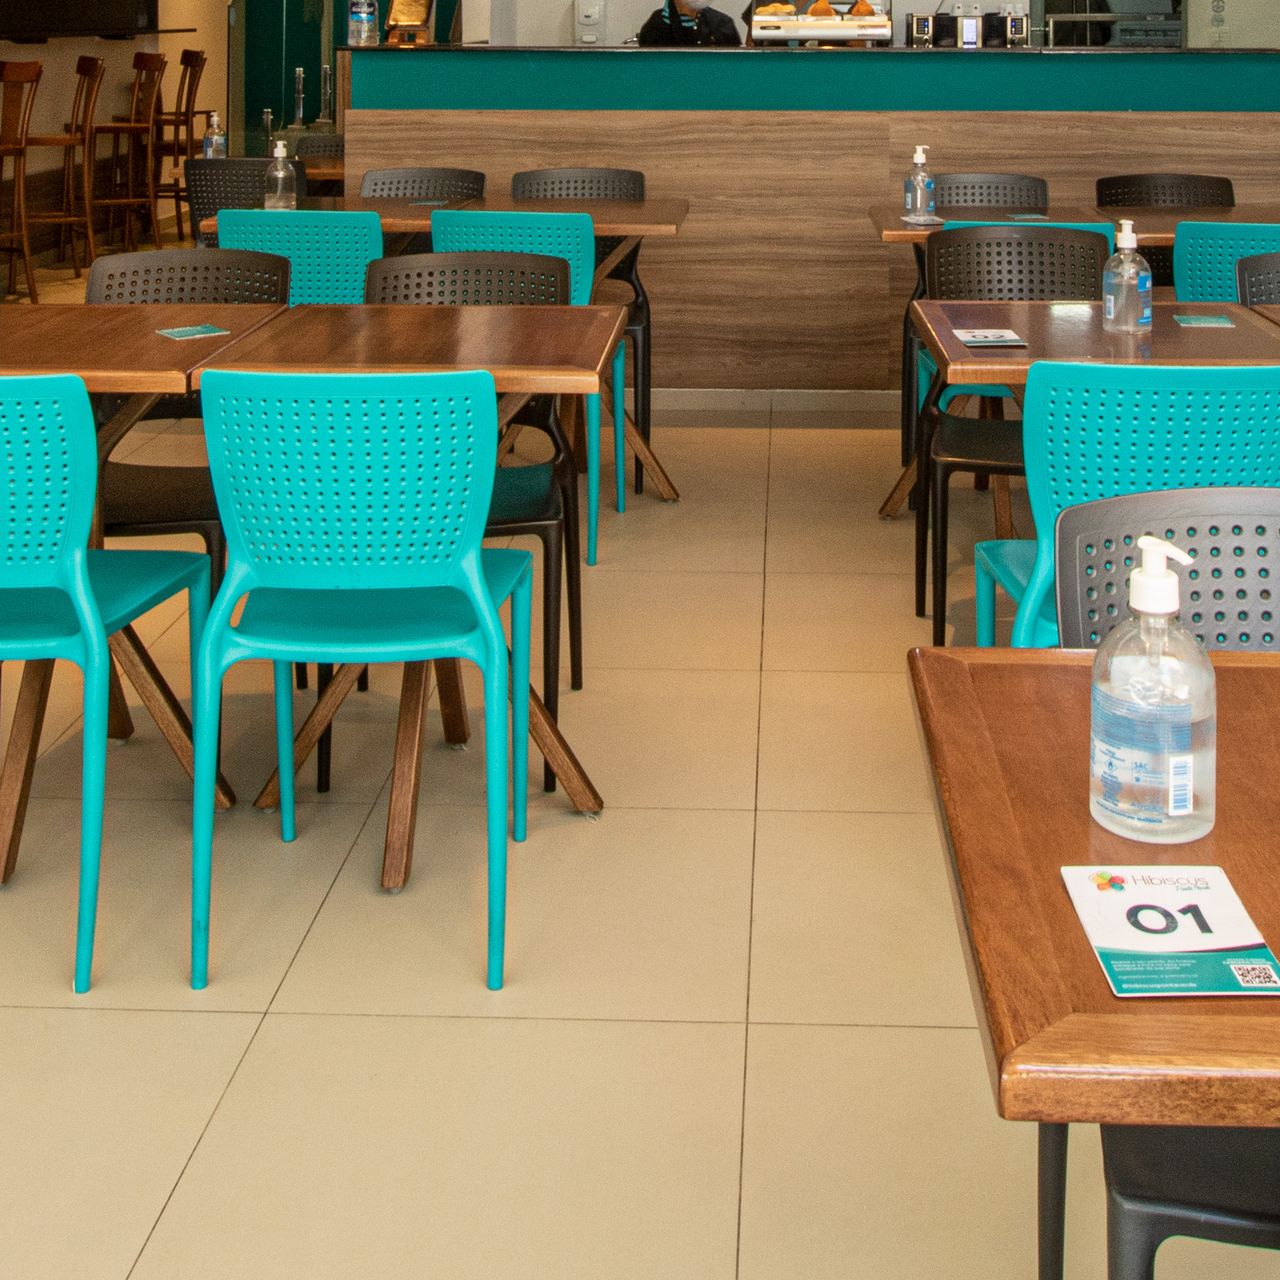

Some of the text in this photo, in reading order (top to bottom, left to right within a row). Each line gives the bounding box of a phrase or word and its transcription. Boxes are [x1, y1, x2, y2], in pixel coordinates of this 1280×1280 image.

[1134, 761, 1148, 770] SAC
[1131, 874, 1209, 887] Hibiscus
[1126, 903, 1214, 935] 01
